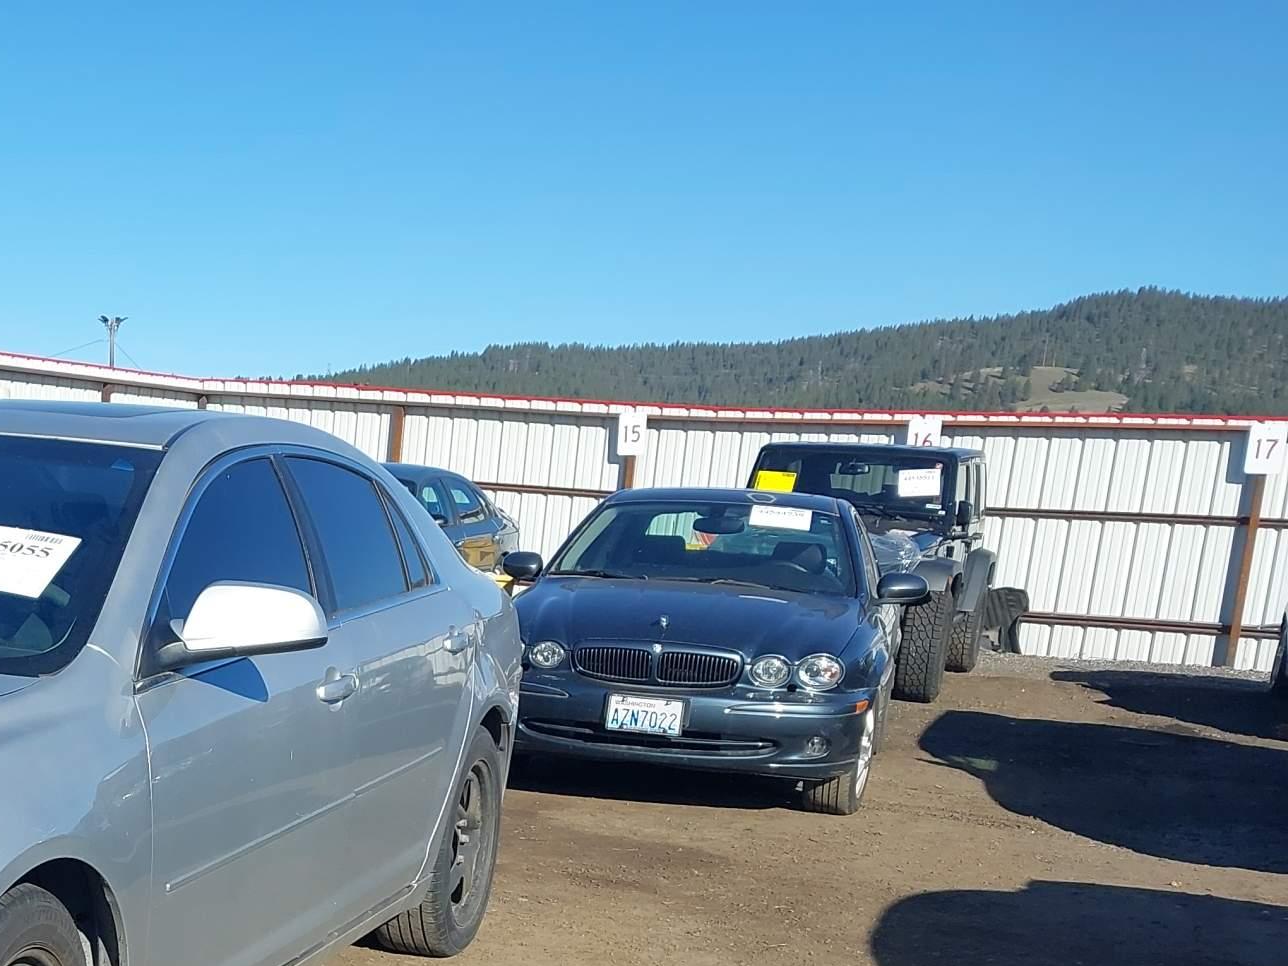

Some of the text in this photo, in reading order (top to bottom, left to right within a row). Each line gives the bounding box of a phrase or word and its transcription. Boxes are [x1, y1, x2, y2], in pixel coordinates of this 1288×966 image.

[623, 424, 641, 443] 15
[1255, 438, 1280, 459] 17
[615, 700, 656, 708] WASHINGTON
[611, 708, 678, 731] AZN7022
